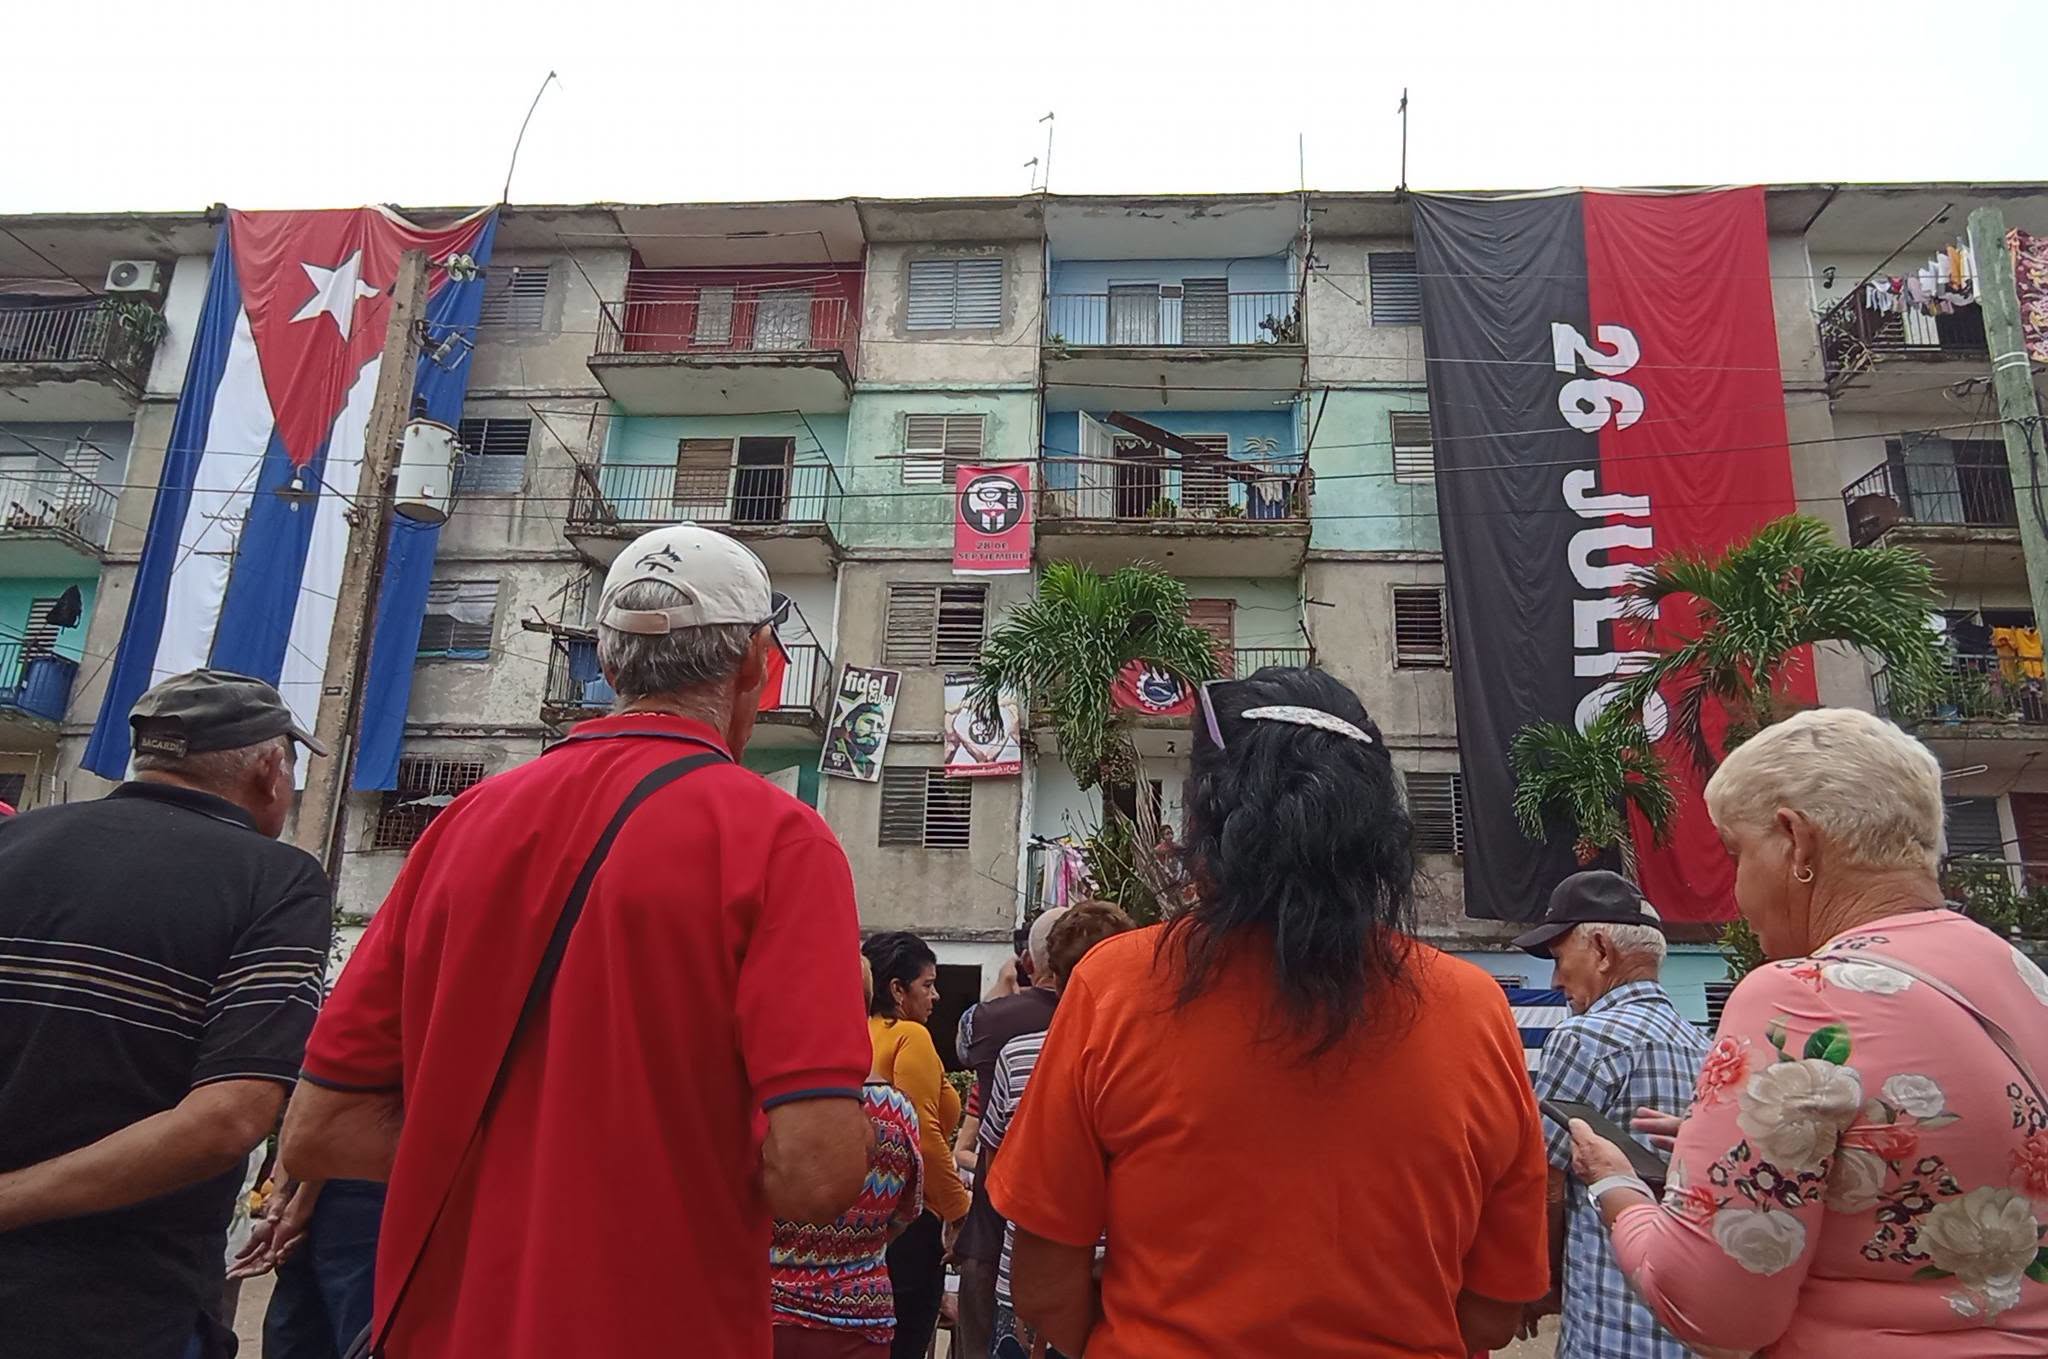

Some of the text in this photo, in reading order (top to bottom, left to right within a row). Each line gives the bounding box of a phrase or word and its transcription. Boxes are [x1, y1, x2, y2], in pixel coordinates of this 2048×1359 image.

[1551, 321, 1669, 745] 26 JULIO
[976, 541, 991, 550] 28
[958, 552, 1025, 561] SEPTIEMBRE
[845, 671, 888, 696] fidel
[867, 691, 894, 706] CUBA
